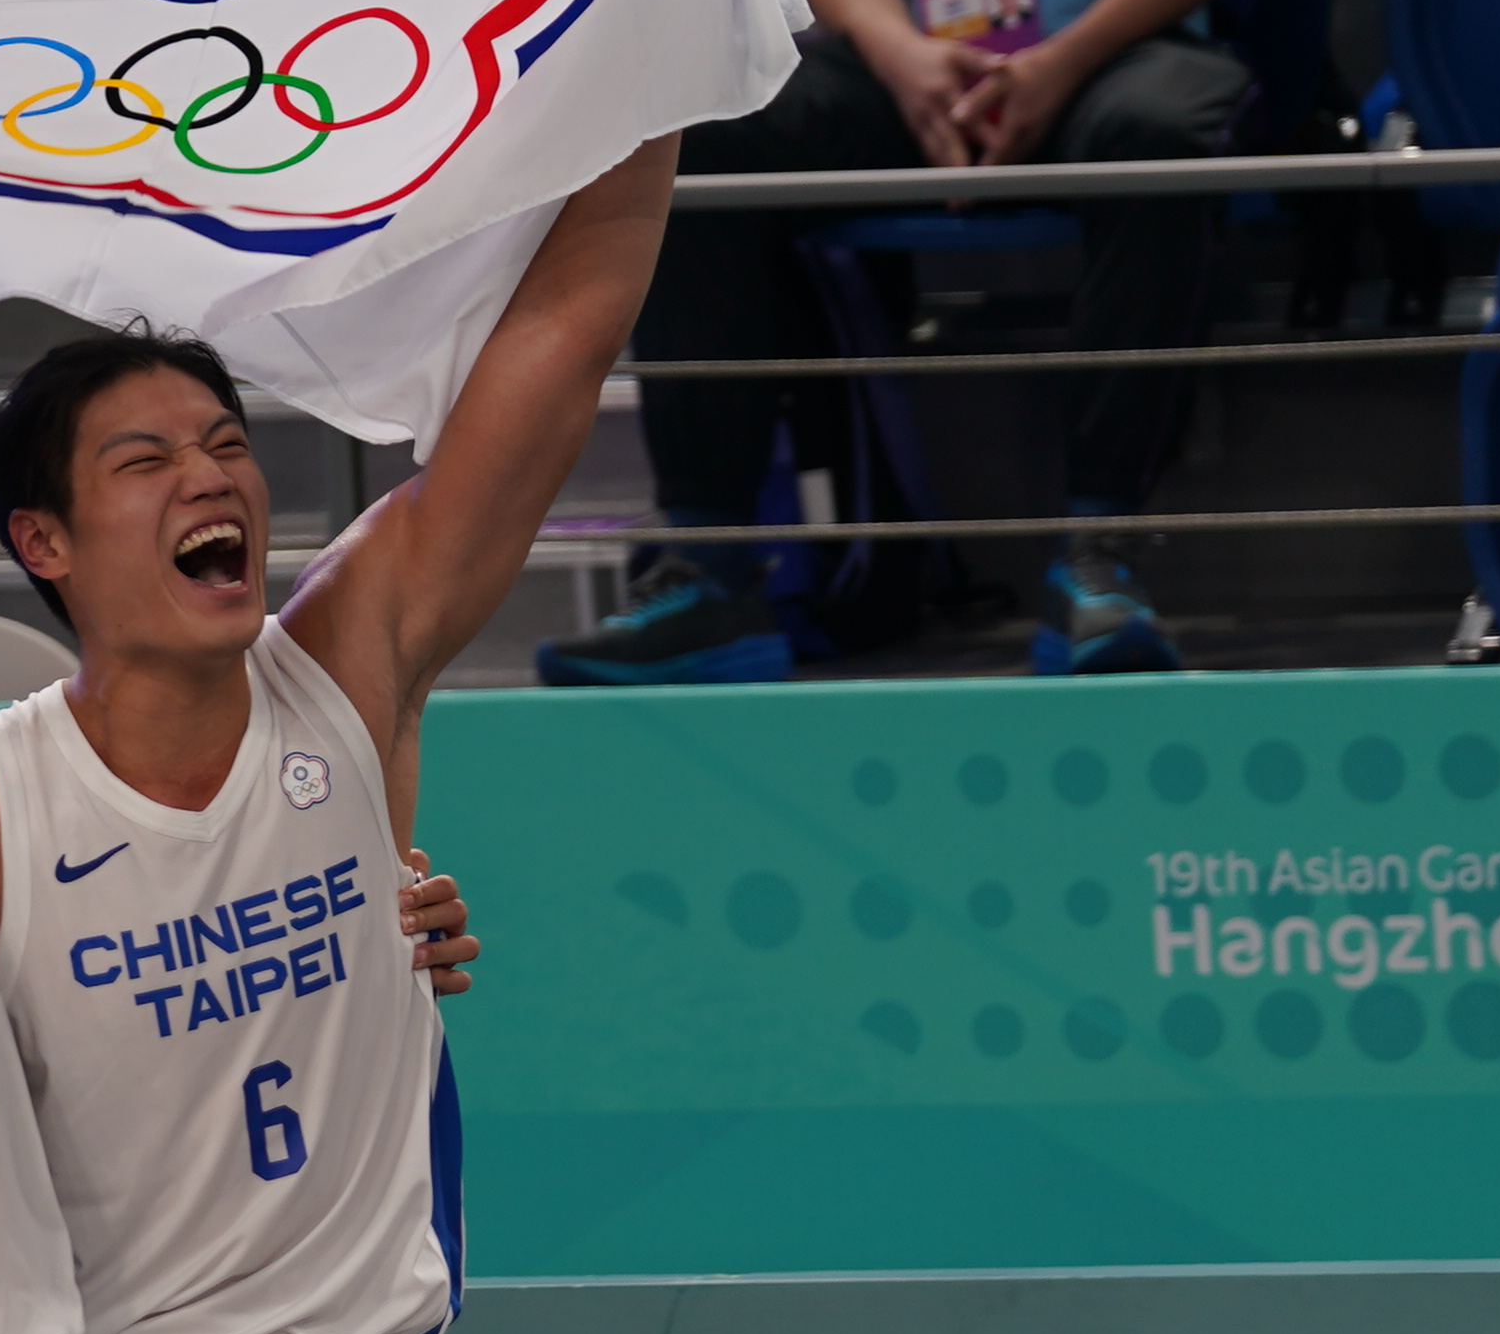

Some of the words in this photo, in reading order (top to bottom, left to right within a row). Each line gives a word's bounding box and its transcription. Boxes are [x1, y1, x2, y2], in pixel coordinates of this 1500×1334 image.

[69, 856, 366, 988] CHINESE
[1145, 850, 1258, 897] 19th
[1268, 847, 1410, 895] Asian
[134, 932, 348, 1038] TAIPEI
[242, 1060, 309, 1182] 6
